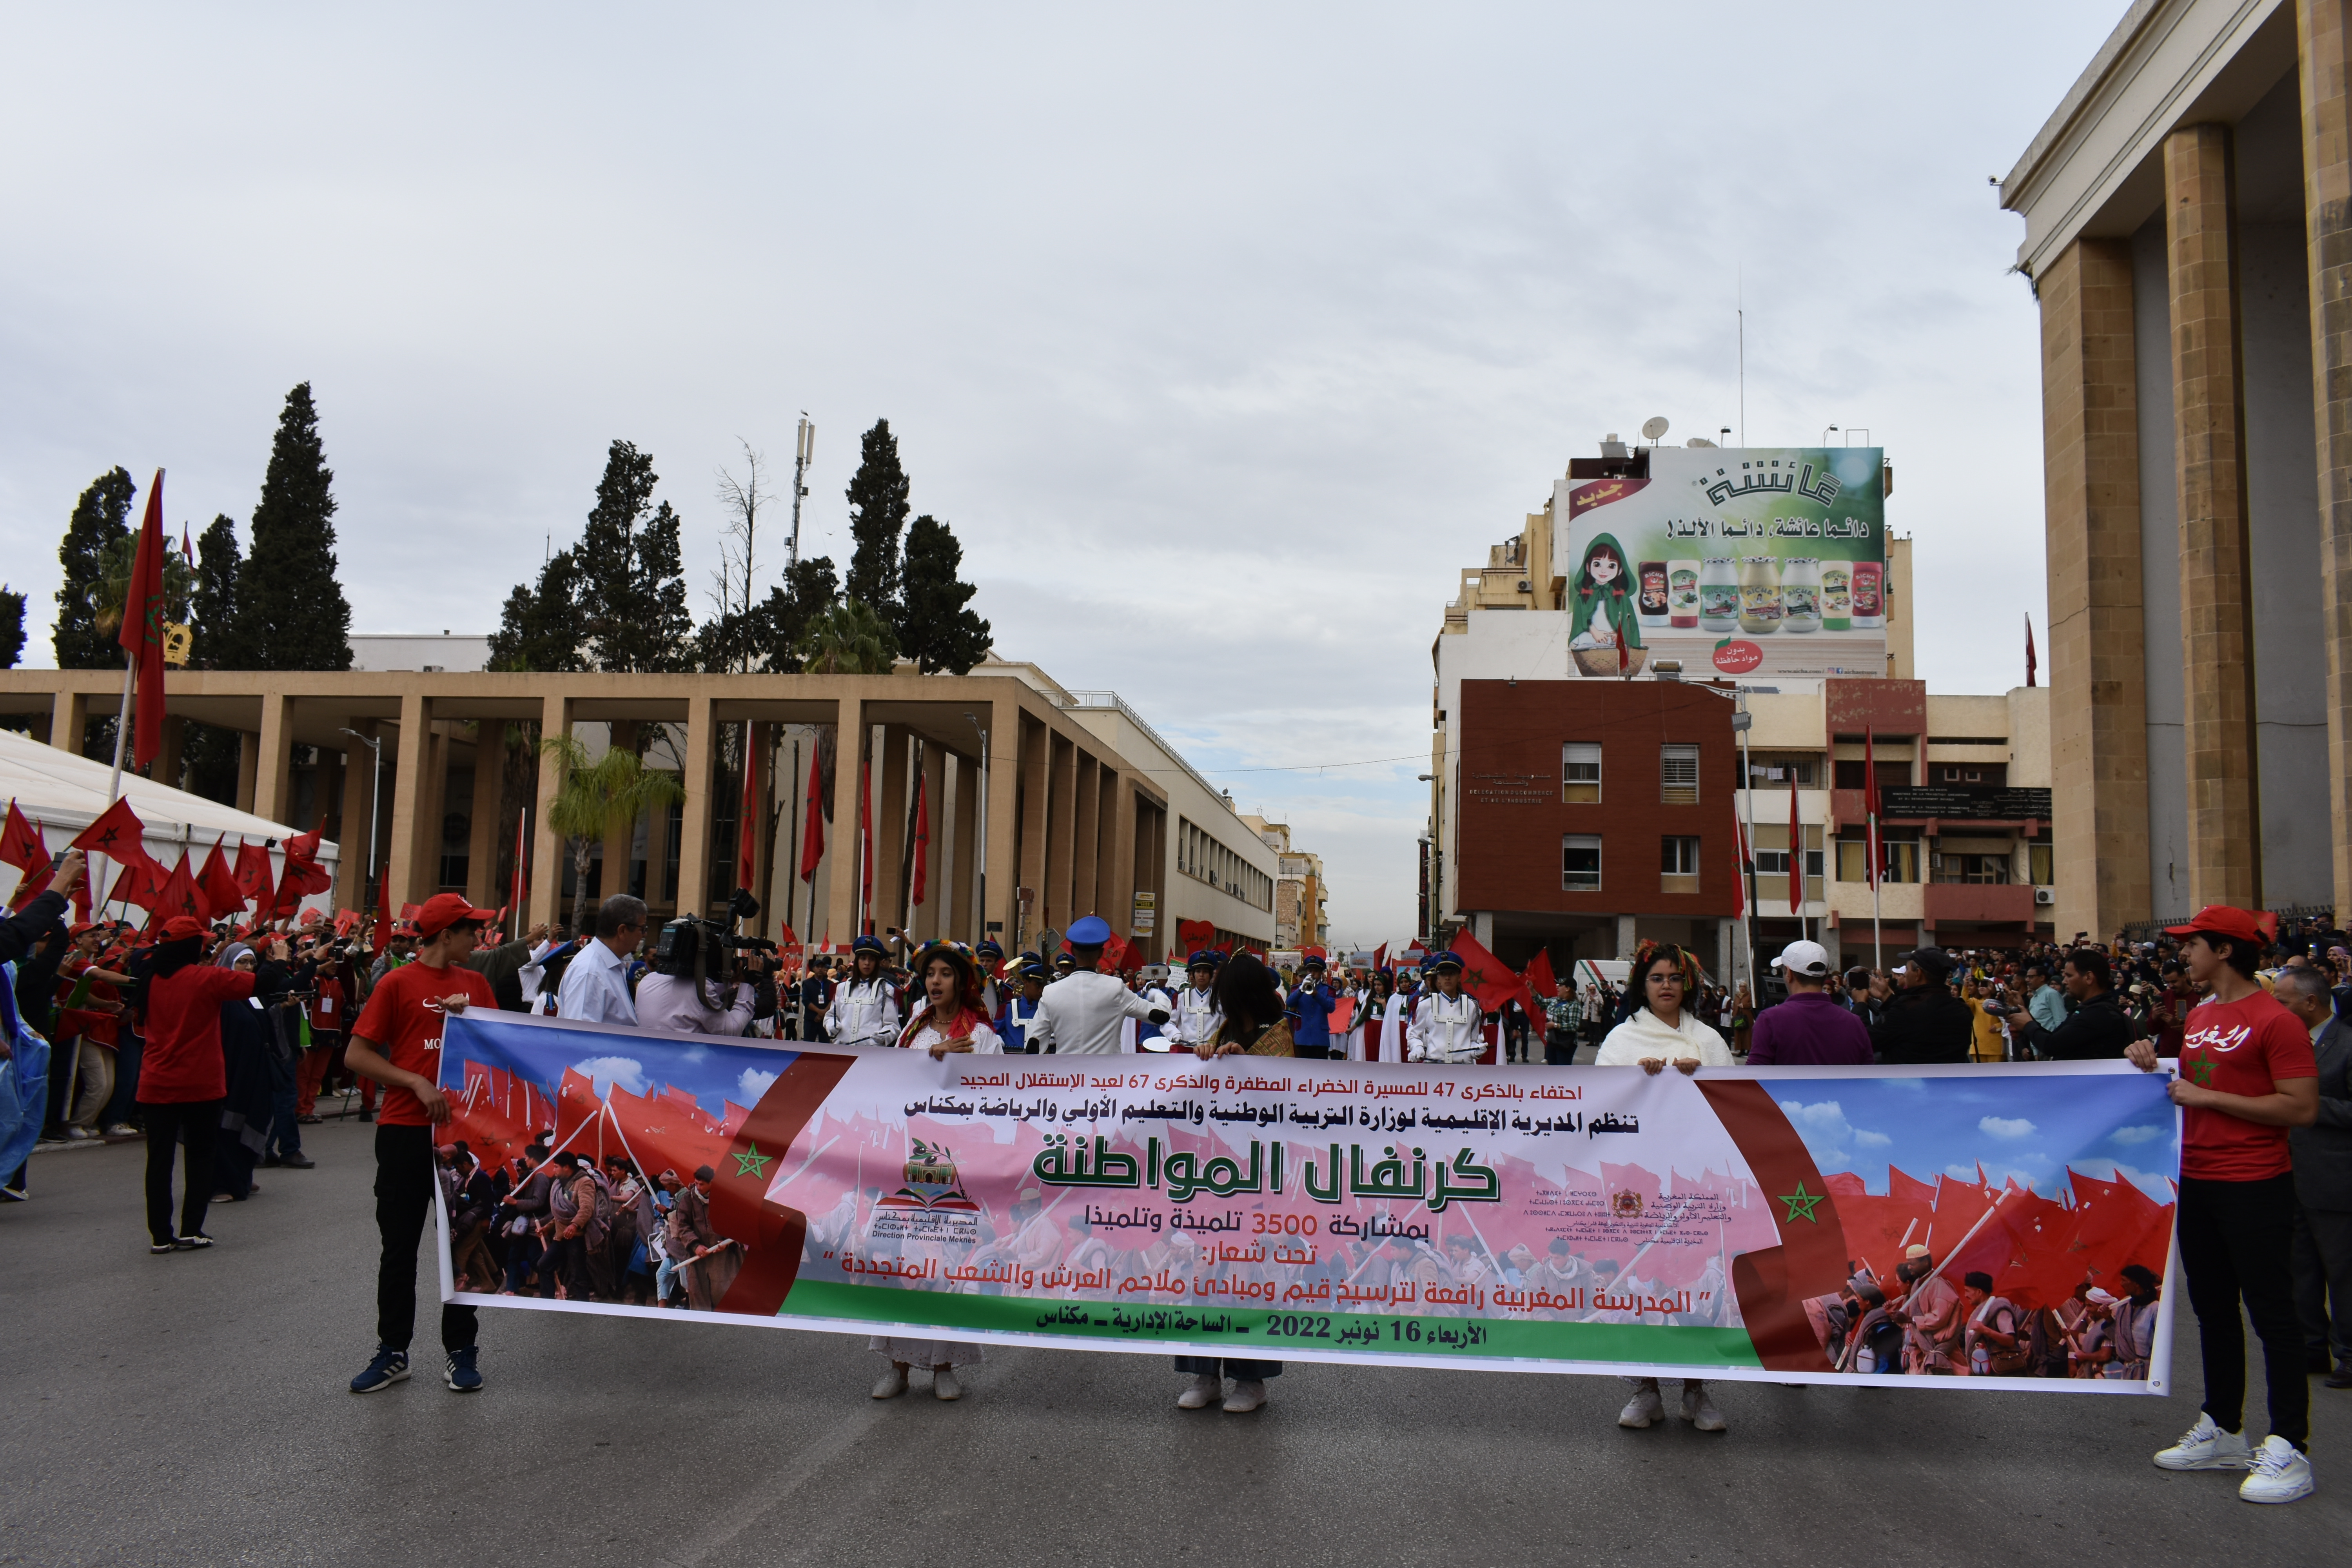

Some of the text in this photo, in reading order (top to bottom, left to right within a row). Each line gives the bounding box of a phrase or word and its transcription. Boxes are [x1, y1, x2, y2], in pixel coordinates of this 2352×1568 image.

[1577, 484, 1623, 506] جديد
[1698, 460, 1842, 508] عائشة
[1727, 647, 1745, 655] بدون
[1185, 933, 1209, 942] الوطن
[2185, 1024, 2250, 1052] المغرب
[960, 1073, 1582, 1102] احتفاء بالذكرى 47 للمسيرة الخضراء المظفرة والذكرى 67 لعيد الإستقلال المجيد
[904, 1094, 1639, 1140] تنظم المديرية الإقليمية لوزارة التربية الوطنية والتعليم الأولي والرياضة بمكناس
[1032, 1132, 1501, 1212] كرنفال المواطنة
[1658, 1193, 1686, 1202] المغربية
[1683, 1203, 1705, 1211] التربية
[1708, 1203, 1726, 1212] وزارة
[875, 1211, 978, 1227] المديرية الإقليمية بمكناس
[1084, 1204, 1430, 1244] بمشاركة 3500 تلميذة وتلميذا
[1699, 1213, 1731, 1223] والتعليم
[872, 1230, 976, 1243] Direction Provinciale Meknès
[1202, 1239, 1318, 1266] تحت شعار:
[841, 1252, 1691, 1316] المدرسة المغربية رافعة لترسيخ قيم ومبادئ ملاحم العرش والشعب المتجددة
[1035, 1305, 1486, 1349] الأربعاء 16 نونبر 2022 الساحة الإدارية مكناس
